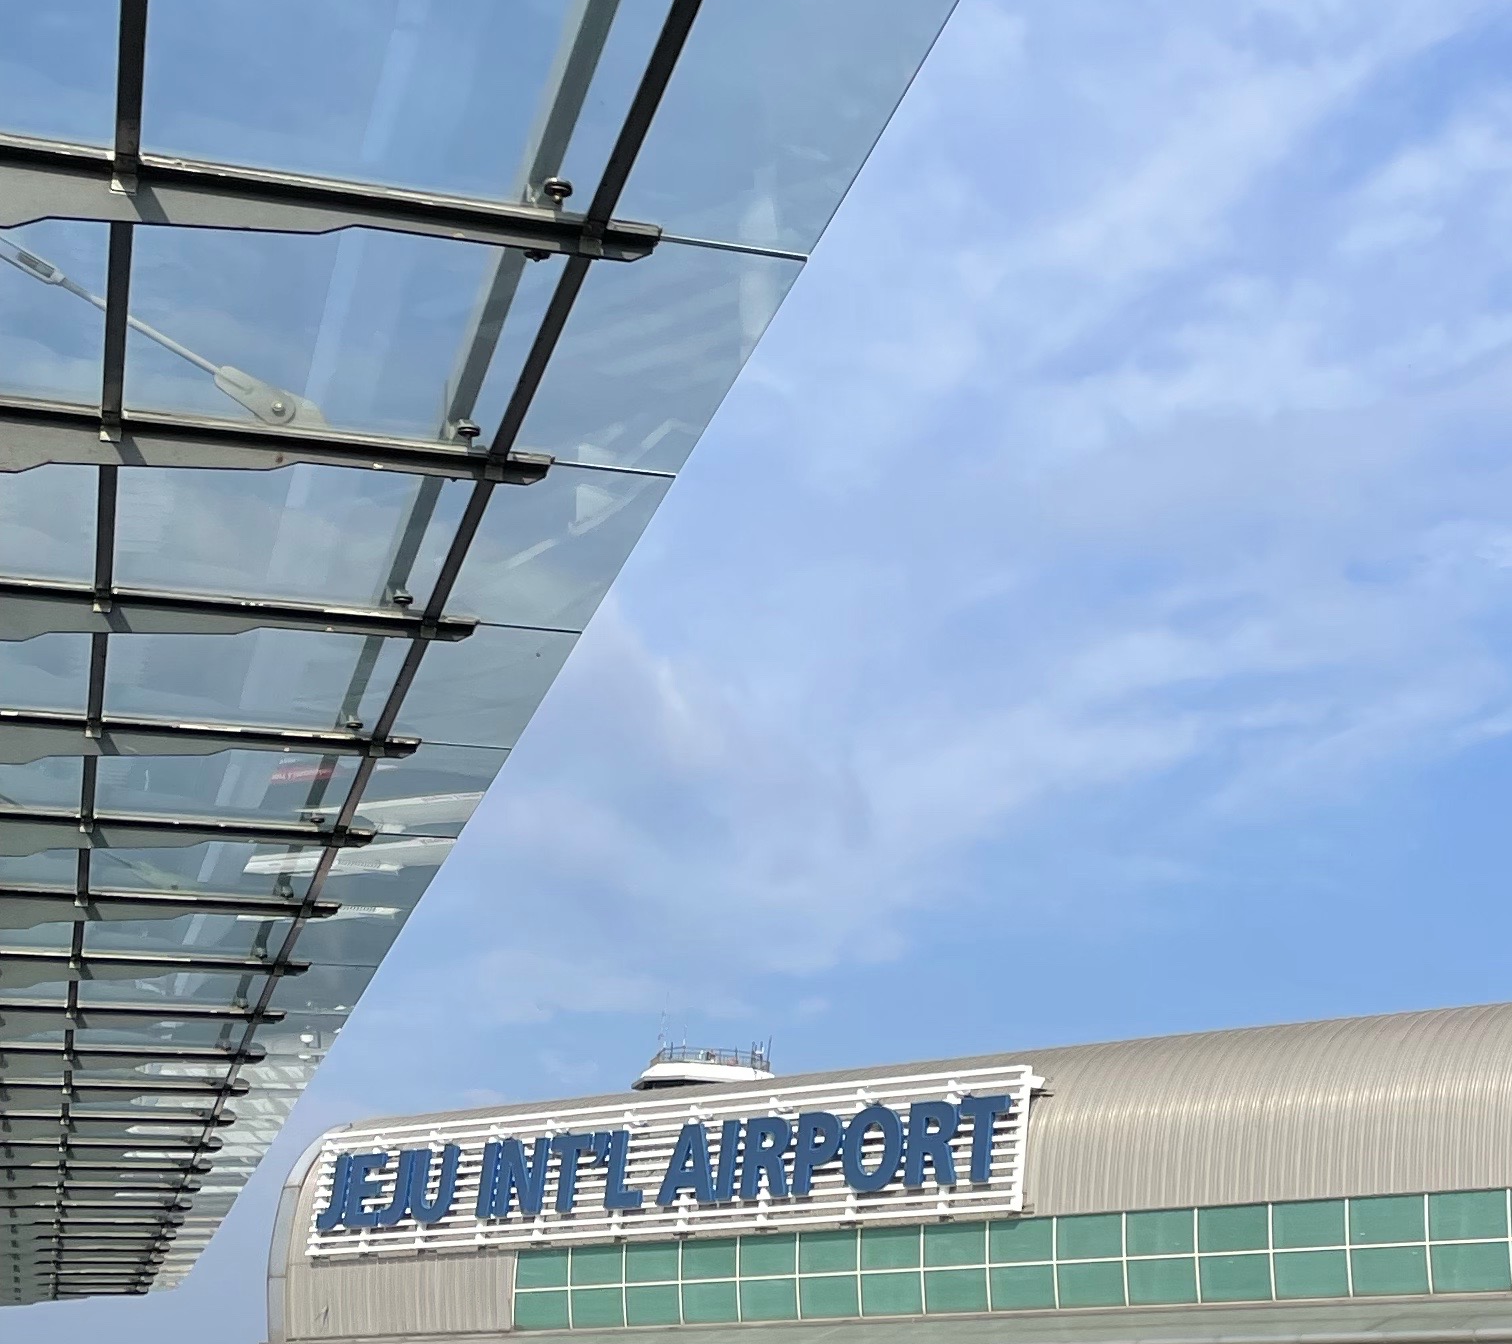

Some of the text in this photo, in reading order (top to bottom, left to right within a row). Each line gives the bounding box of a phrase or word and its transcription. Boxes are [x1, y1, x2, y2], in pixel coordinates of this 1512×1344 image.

[315, 1094, 1012, 1230] JEJU INT'L AIRPORT
